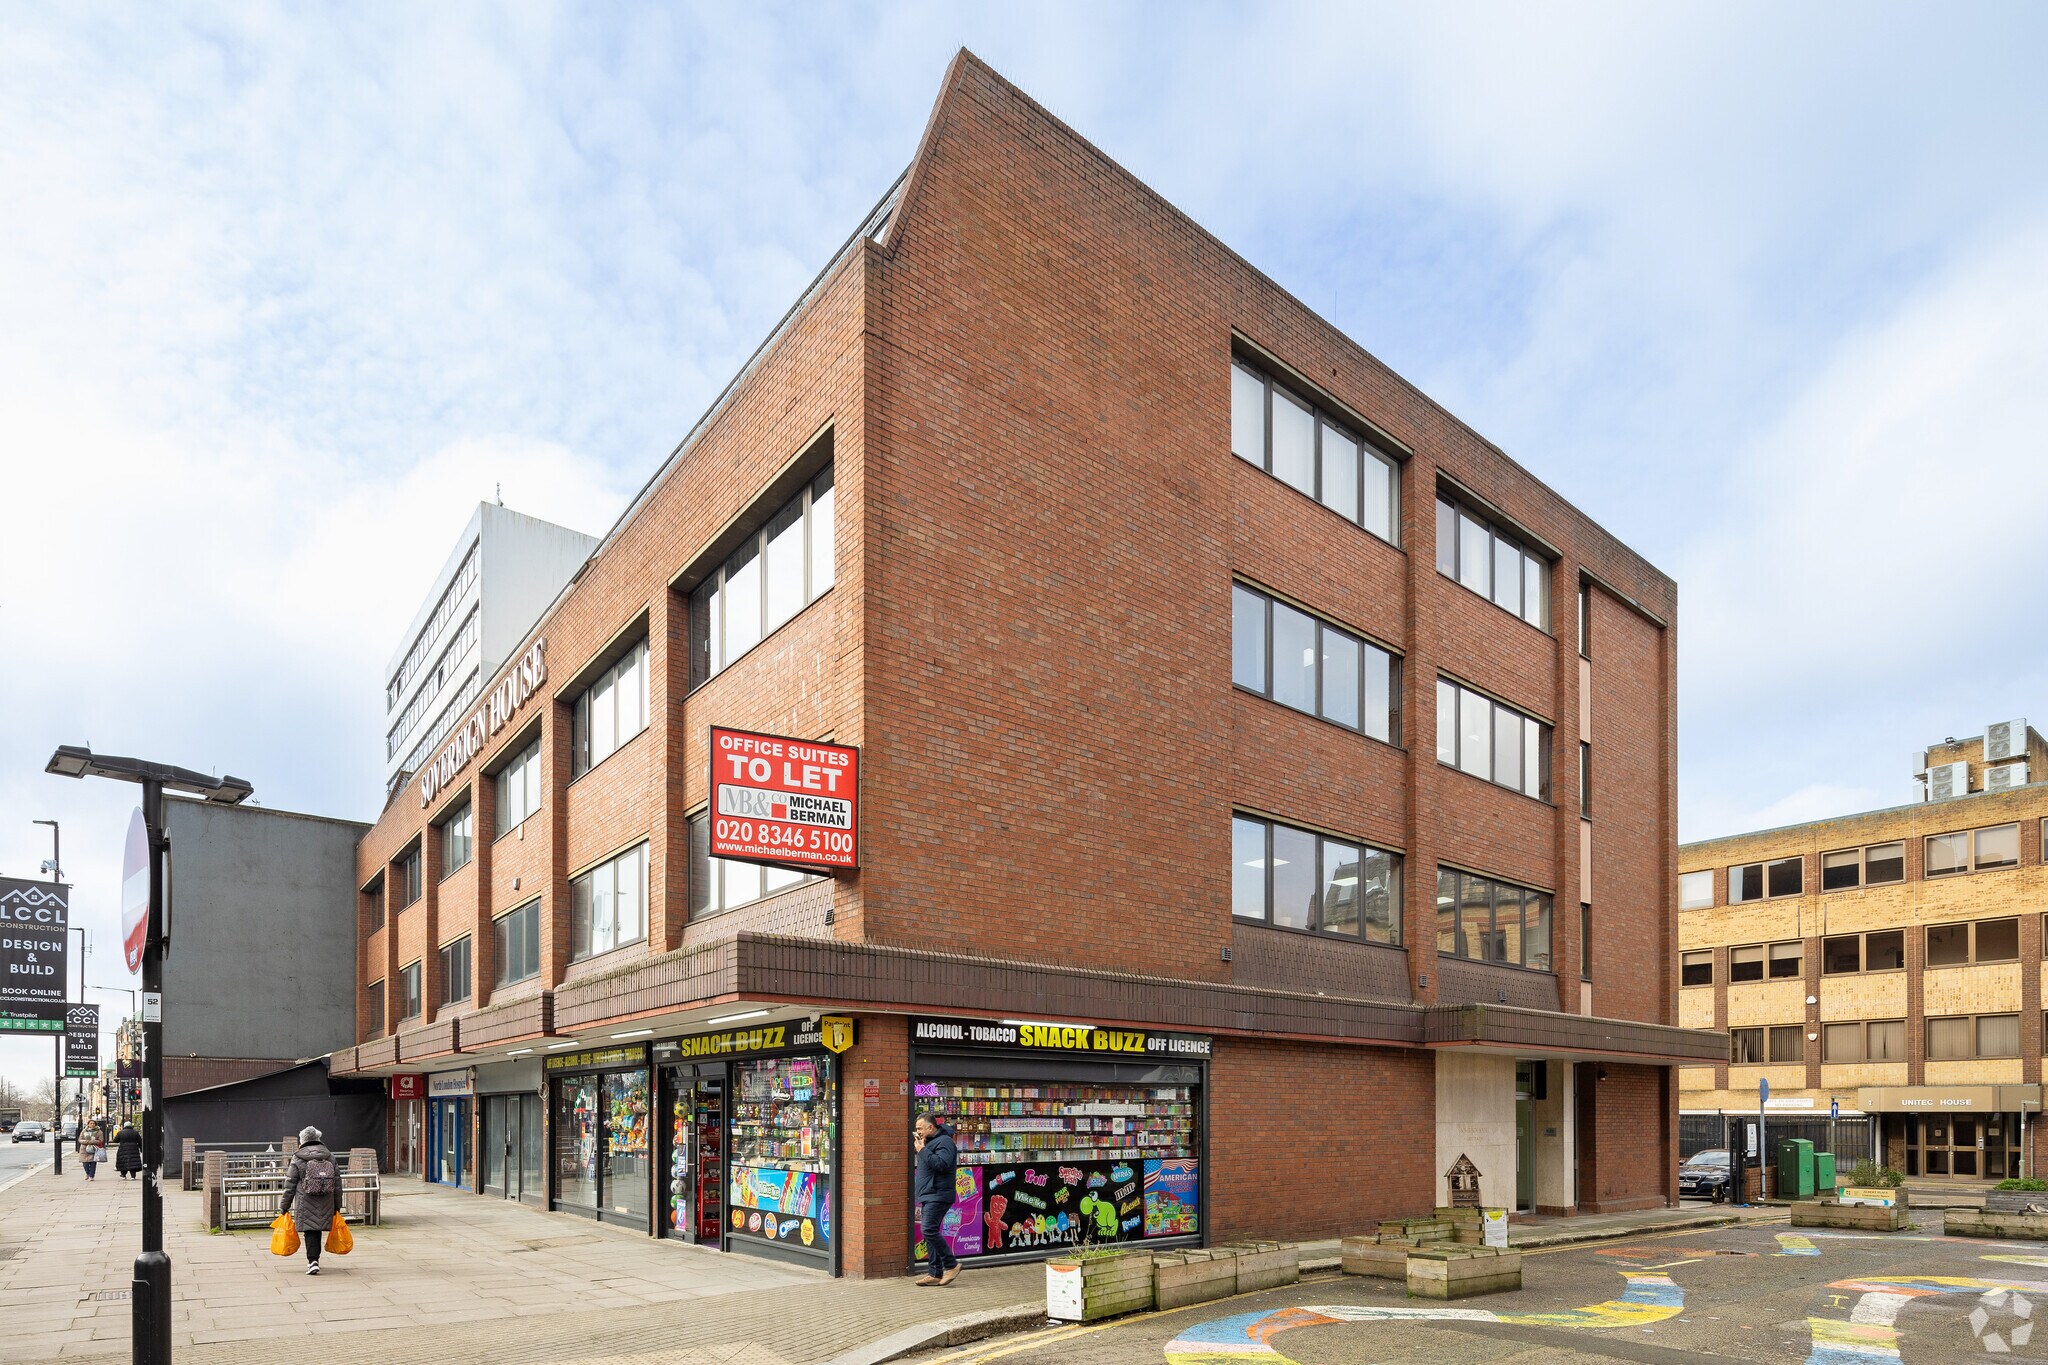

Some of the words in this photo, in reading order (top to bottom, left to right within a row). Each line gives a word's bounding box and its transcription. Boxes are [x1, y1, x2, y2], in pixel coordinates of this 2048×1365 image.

[421, 703, 490, 809] SOVEREIGN
[490, 637, 549, 736] HOUSE
[719, 735, 783, 757] OFFICE
[788, 746, 849, 766] SUITES
[726, 754, 772, 783] TO
[783, 762, 842, 792] LET
[789, 795, 847, 814] MICHAEL
[790, 809, 846, 827] BERMAN
[716, 819, 753, 842] 020
[758, 824, 805, 847] 8346
[810, 830, 853, 853] 5100
[716, 842, 852, 863] www.michaelberman.co.uk
[0, 905, 66, 924] LCCL
[0, 921, 66, 932] CONSTRUCTION
[2, 938, 62, 952] DESIGN
[27, 952, 38, 963] &
[10, 963, 55, 976] BUILD
[2, 987, 28, 996] BOOK
[30, 988, 62, 997] ONLINE
[10, 1011, 38, 1019] Trustpilot
[66, 1016, 98, 1025] LCCL
[801, 1020, 815, 1032] OFF
[681, 1033, 733, 1058] SNACK
[735, 1026, 786, 1052] BUZZ
[793, 1032, 823, 1046] LICENCE
[916, 1022, 964, 1040] ALCOHOL
[969, 1026, 1017, 1043] TOBACCO
[1020, 1024, 1090, 1050] SNACK
[1093, 1030, 1146, 1053] BUZZ
[1147, 1038, 1167, 1051] OFF
[1168, 1039, 1210, 1054] LICENCE
[792, 1061, 809, 1072] VAPE
[770, 1077, 789, 1089] OPEN
[1025, 1169, 1048, 1187] Trolli
[1160, 1173, 1198, 1182] AMERICAN
[957, 1234, 980, 1242] American
[964, 1242, 980, 1252] Candy
